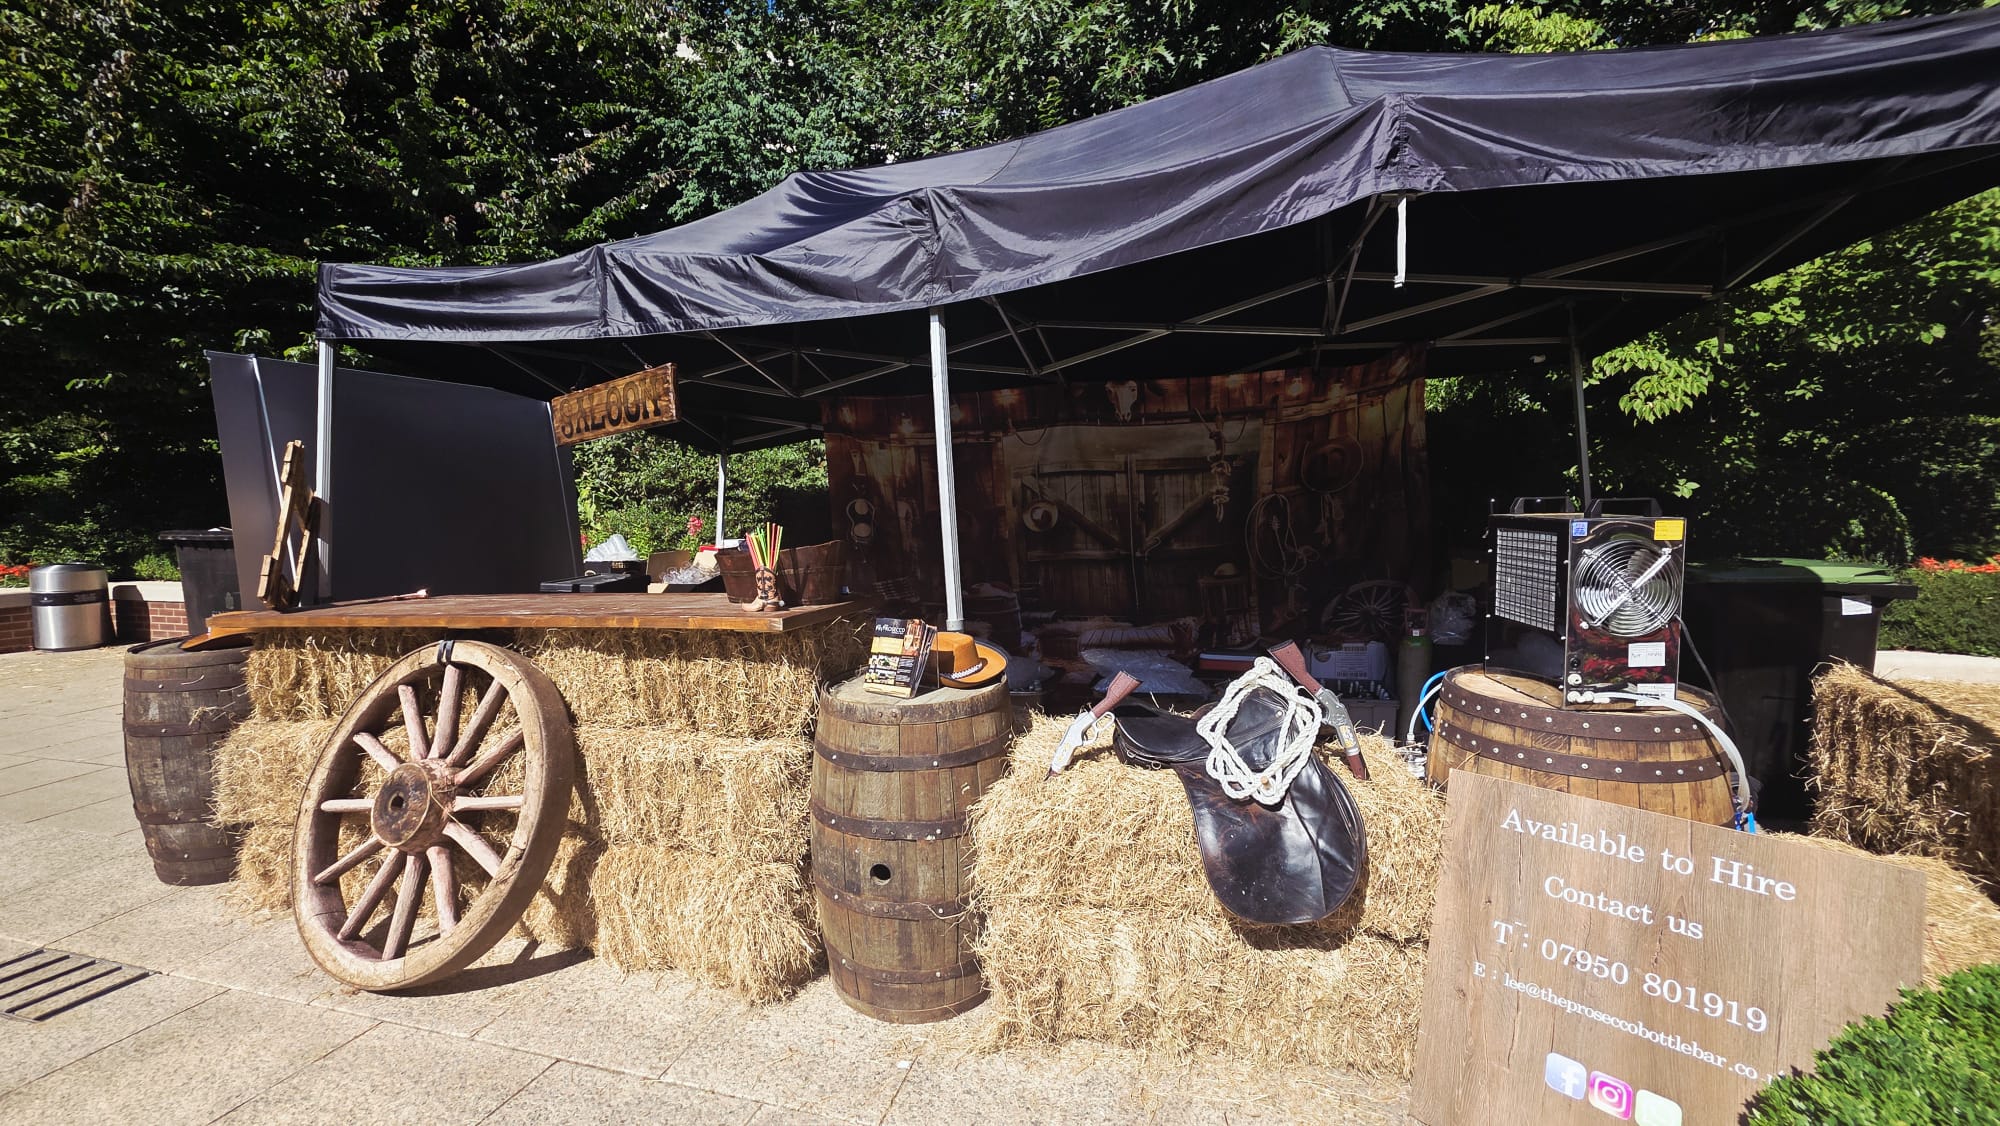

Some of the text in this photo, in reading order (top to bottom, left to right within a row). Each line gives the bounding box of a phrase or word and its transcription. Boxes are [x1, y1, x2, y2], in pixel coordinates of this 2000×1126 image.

[559, 375, 662, 439] SALOON
[1500, 808, 1796, 901] Available to Hire
[1544, 876, 1703, 939] Contact us
[1503, 973, 1786, 1085] lee@theproseccobottlebar.co.
[1541, 939, 1629, 985] 07950
[1642, 972, 1767, 1034] 801919
